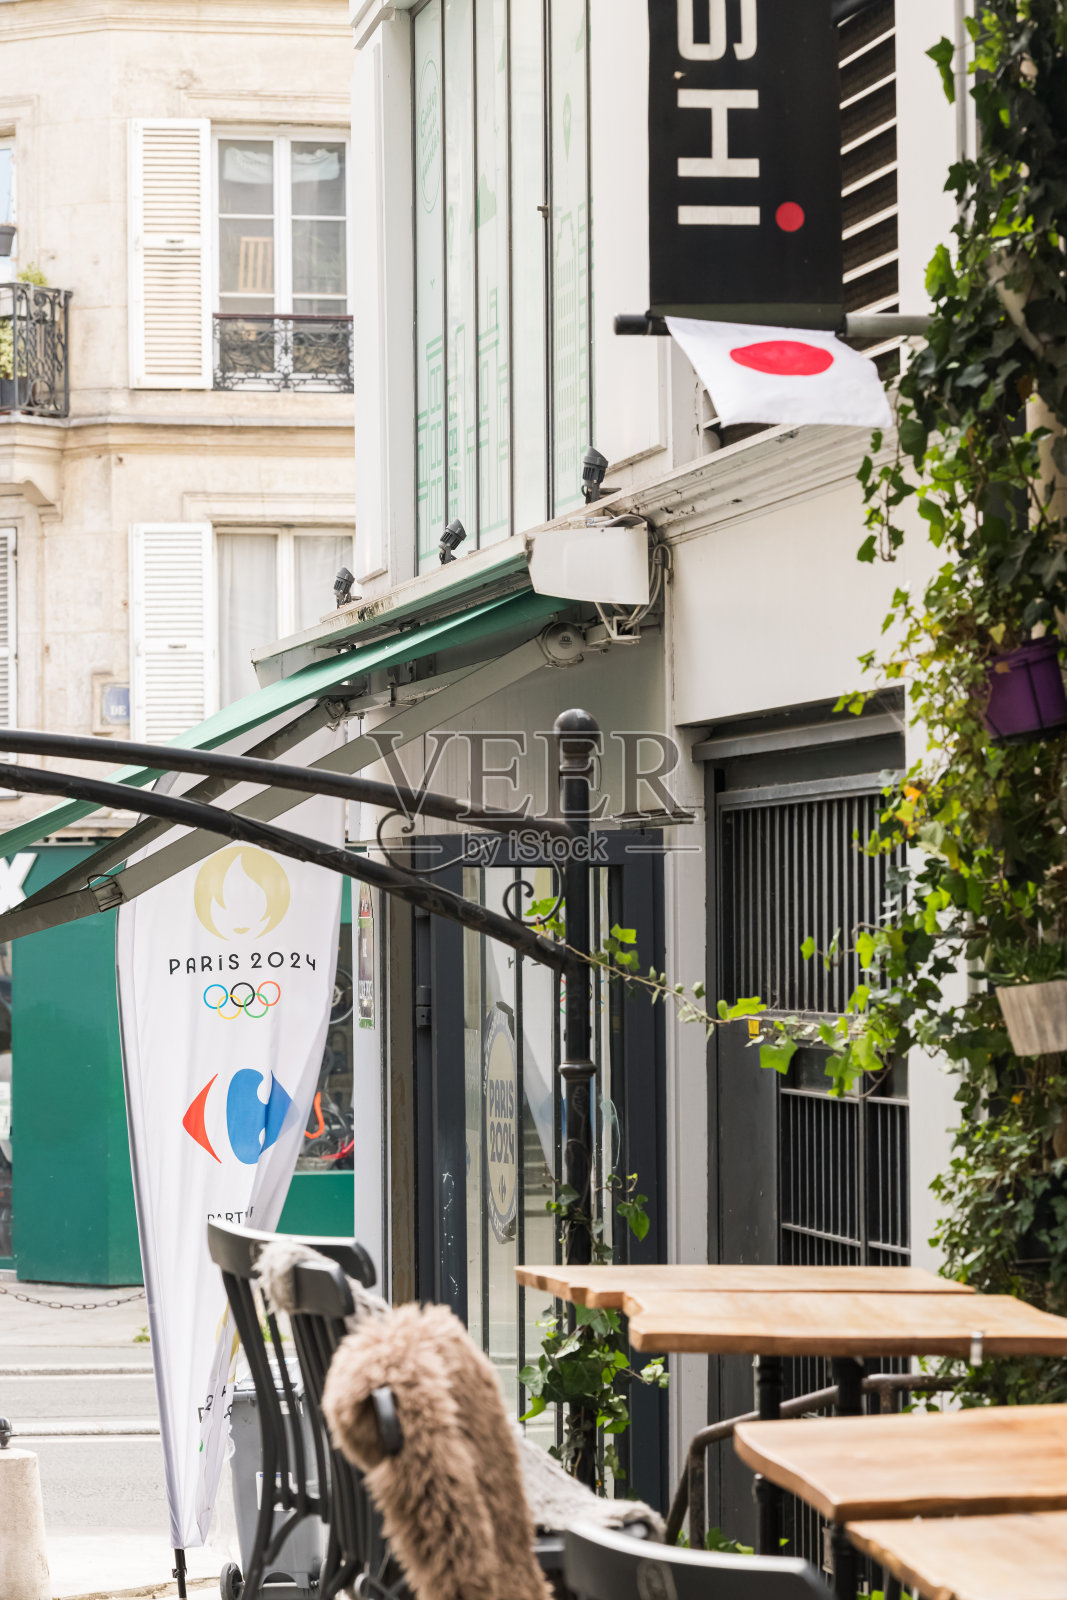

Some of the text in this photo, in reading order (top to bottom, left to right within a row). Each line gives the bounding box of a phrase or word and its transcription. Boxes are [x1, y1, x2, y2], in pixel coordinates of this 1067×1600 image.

[251, 951, 316, 971] 2024
[489, 1079, 514, 1120] PARIS
[489, 1121, 515, 1165] 2024
